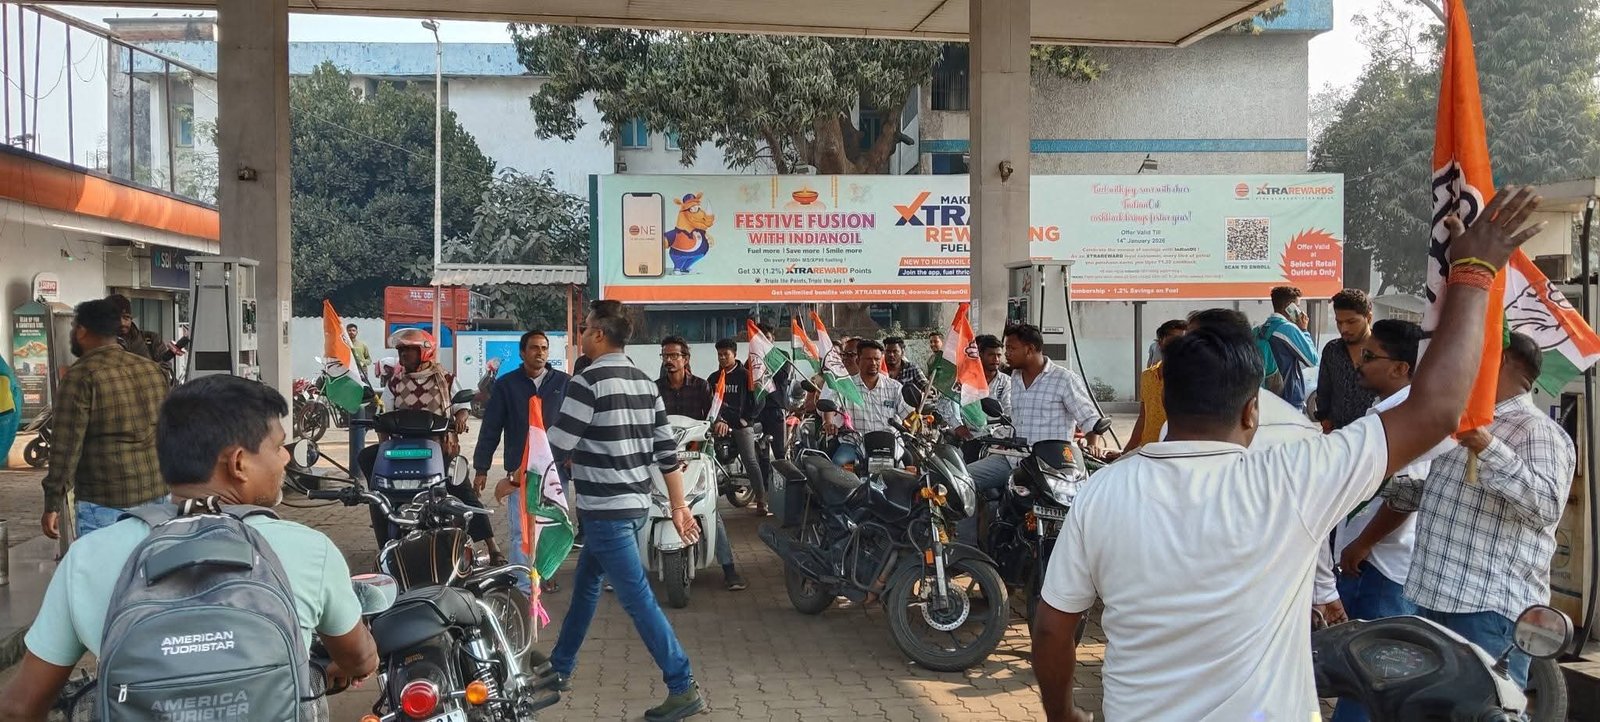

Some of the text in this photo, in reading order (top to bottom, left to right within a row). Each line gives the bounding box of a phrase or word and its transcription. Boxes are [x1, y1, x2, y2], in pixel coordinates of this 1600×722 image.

[1256, 183, 1335, 195] XTRAREWARDS
[735, 213, 876, 229] FESTIVE FUSION
[748, 232, 863, 244] WITH INDIANOIL
[161, 252, 172, 269] SBI
[1315, 259, 1337, 267] Retail
[738, 263, 872, 276] Get 3X (1.2%) XTRAREWARD Points
[1291, 268, 1336, 278] Outlets Only
[160, 630, 235, 647] AMERICAN
[150, 688, 249, 712] AMERICA
